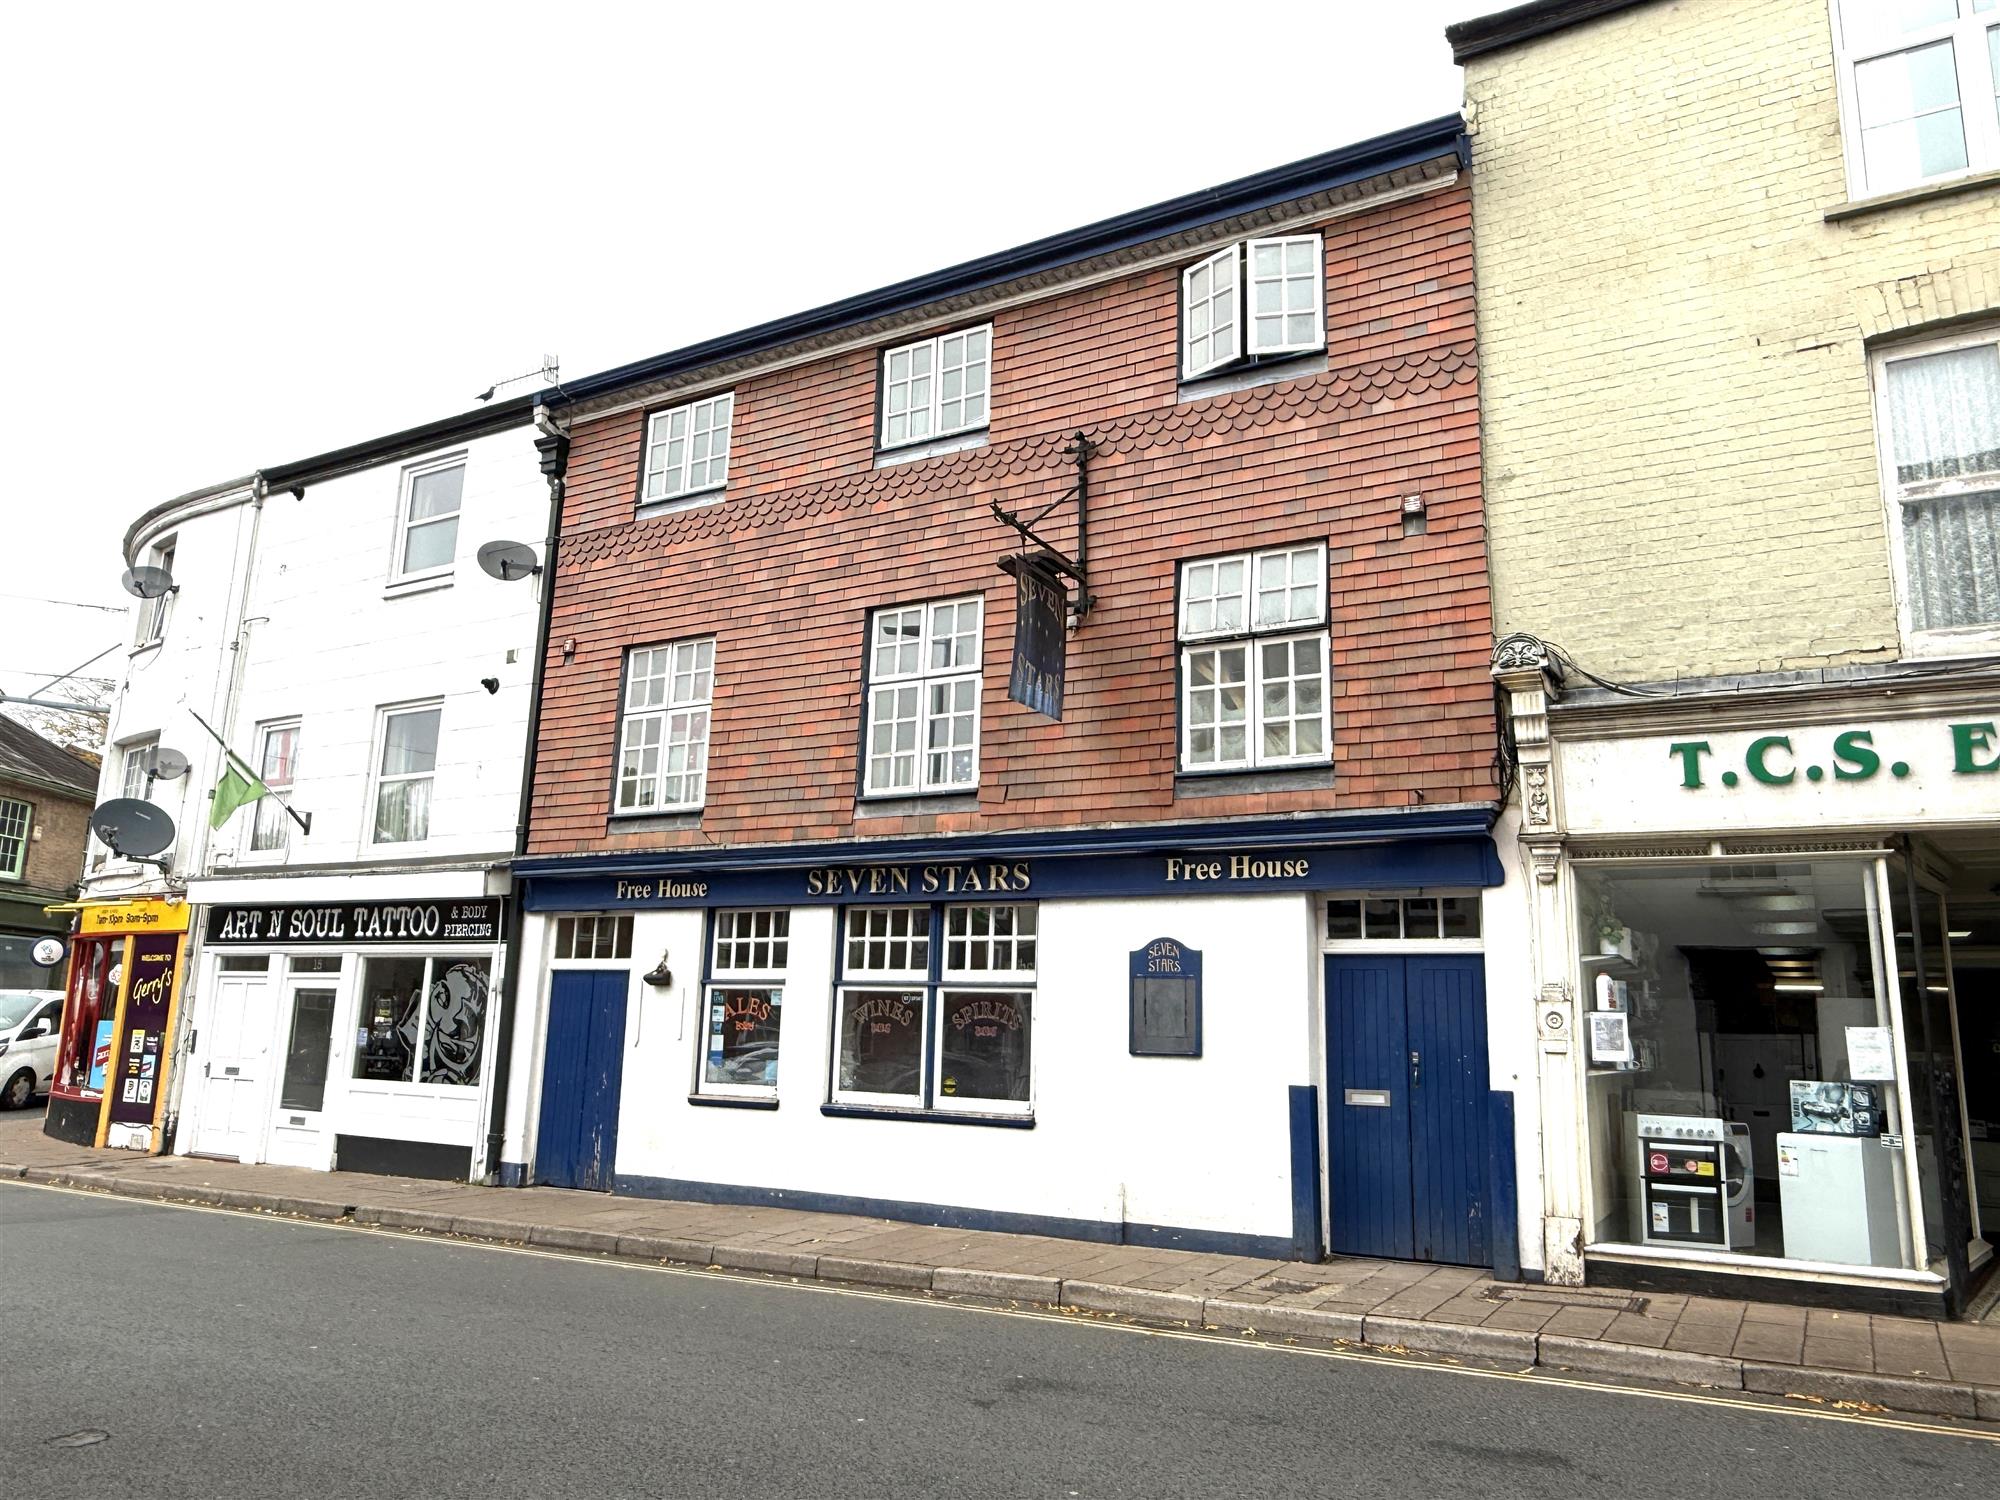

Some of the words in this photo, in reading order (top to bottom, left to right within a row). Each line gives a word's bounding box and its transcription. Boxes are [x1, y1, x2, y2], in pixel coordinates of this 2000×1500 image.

[1020, 572, 1065, 628] SEVEN
[1016, 652, 1061, 700] STARS
[1669, 729, 1909, 788] T.C.S.
[807, 866, 910, 896] SEVEN
[921, 863, 1031, 893] STARS
[1165, 857, 1222, 881] Free
[1228, 855, 1309, 879] House
[616, 880, 652, 899] Free
[657, 879, 708, 899] House
[219, 910, 262, 939] ART
[266, 910, 285, 938] N
[289, 908, 346, 938] SOUL
[353, 905, 440, 938] TATTOO
[451, 909, 458, 918] &
[461, 905, 488, 919] BODY
[443, 923, 493, 938] PIERCING
[1148, 942, 1181, 960] SEVEN
[1148, 958, 1181, 973] STARS
[133, 967, 173, 1006] Gerry's
[725, 997, 771, 1021] ALES
[851, 999, 914, 1026] WINES
[951, 1001, 1023, 1031] SPIRITS
